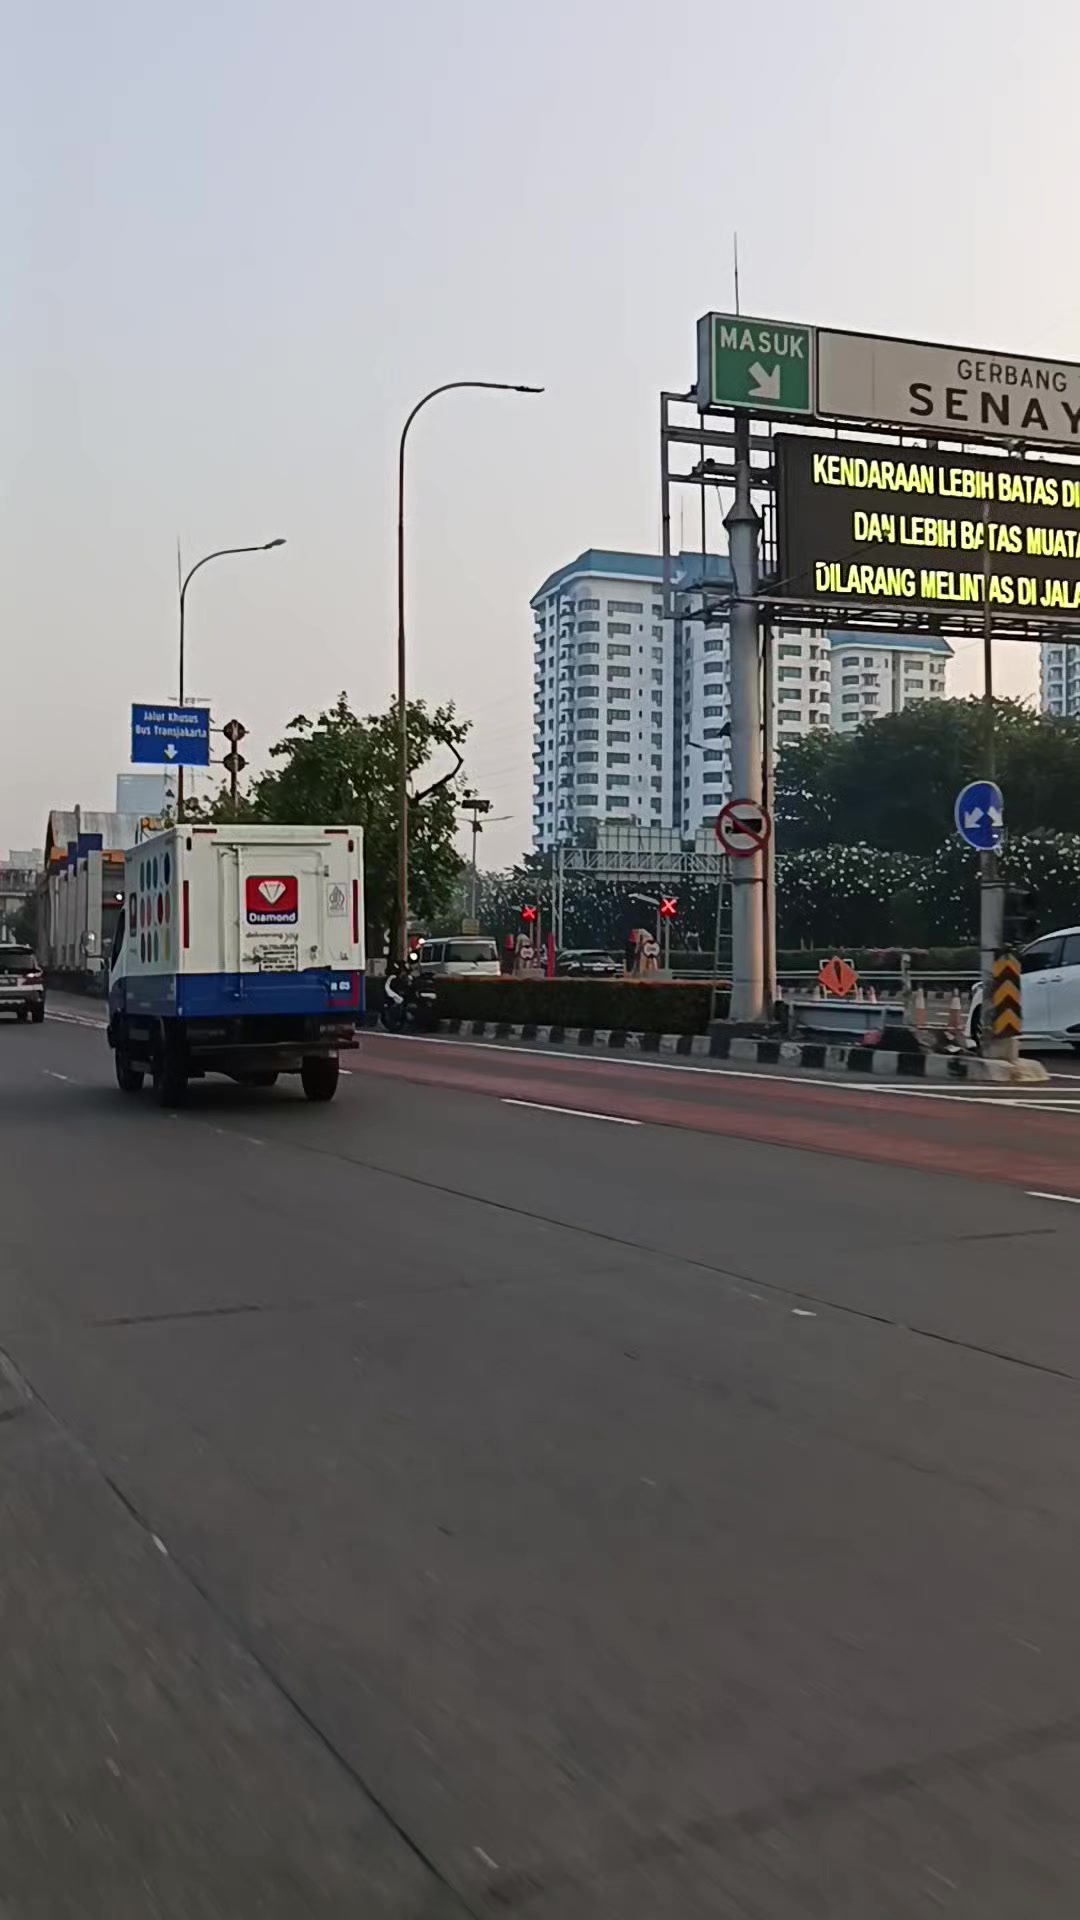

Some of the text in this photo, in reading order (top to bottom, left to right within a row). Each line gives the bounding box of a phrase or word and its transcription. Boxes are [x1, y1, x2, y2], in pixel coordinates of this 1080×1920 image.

[720, 325, 804, 359] MASUK
[957, 358, 1067, 392] GERBANG
[909, 382, 1080, 434] SENAY
[813, 453, 934, 494] KENDARAAN
[939, 467, 994, 500] LEBIH
[998, 472, 1059, 506] BATAS
[854, 511, 896, 543] DAN
[900, 515, 956, 549] LEBIH
[960, 520, 1022, 553] BATAS
[815, 561, 916, 598] DILARANG
[1017, 577, 1037, 606] DI
[135, 724, 151, 736] Bus
[144, 711, 165, 721] Jalur
[249, 913, 296, 922] Diamond
